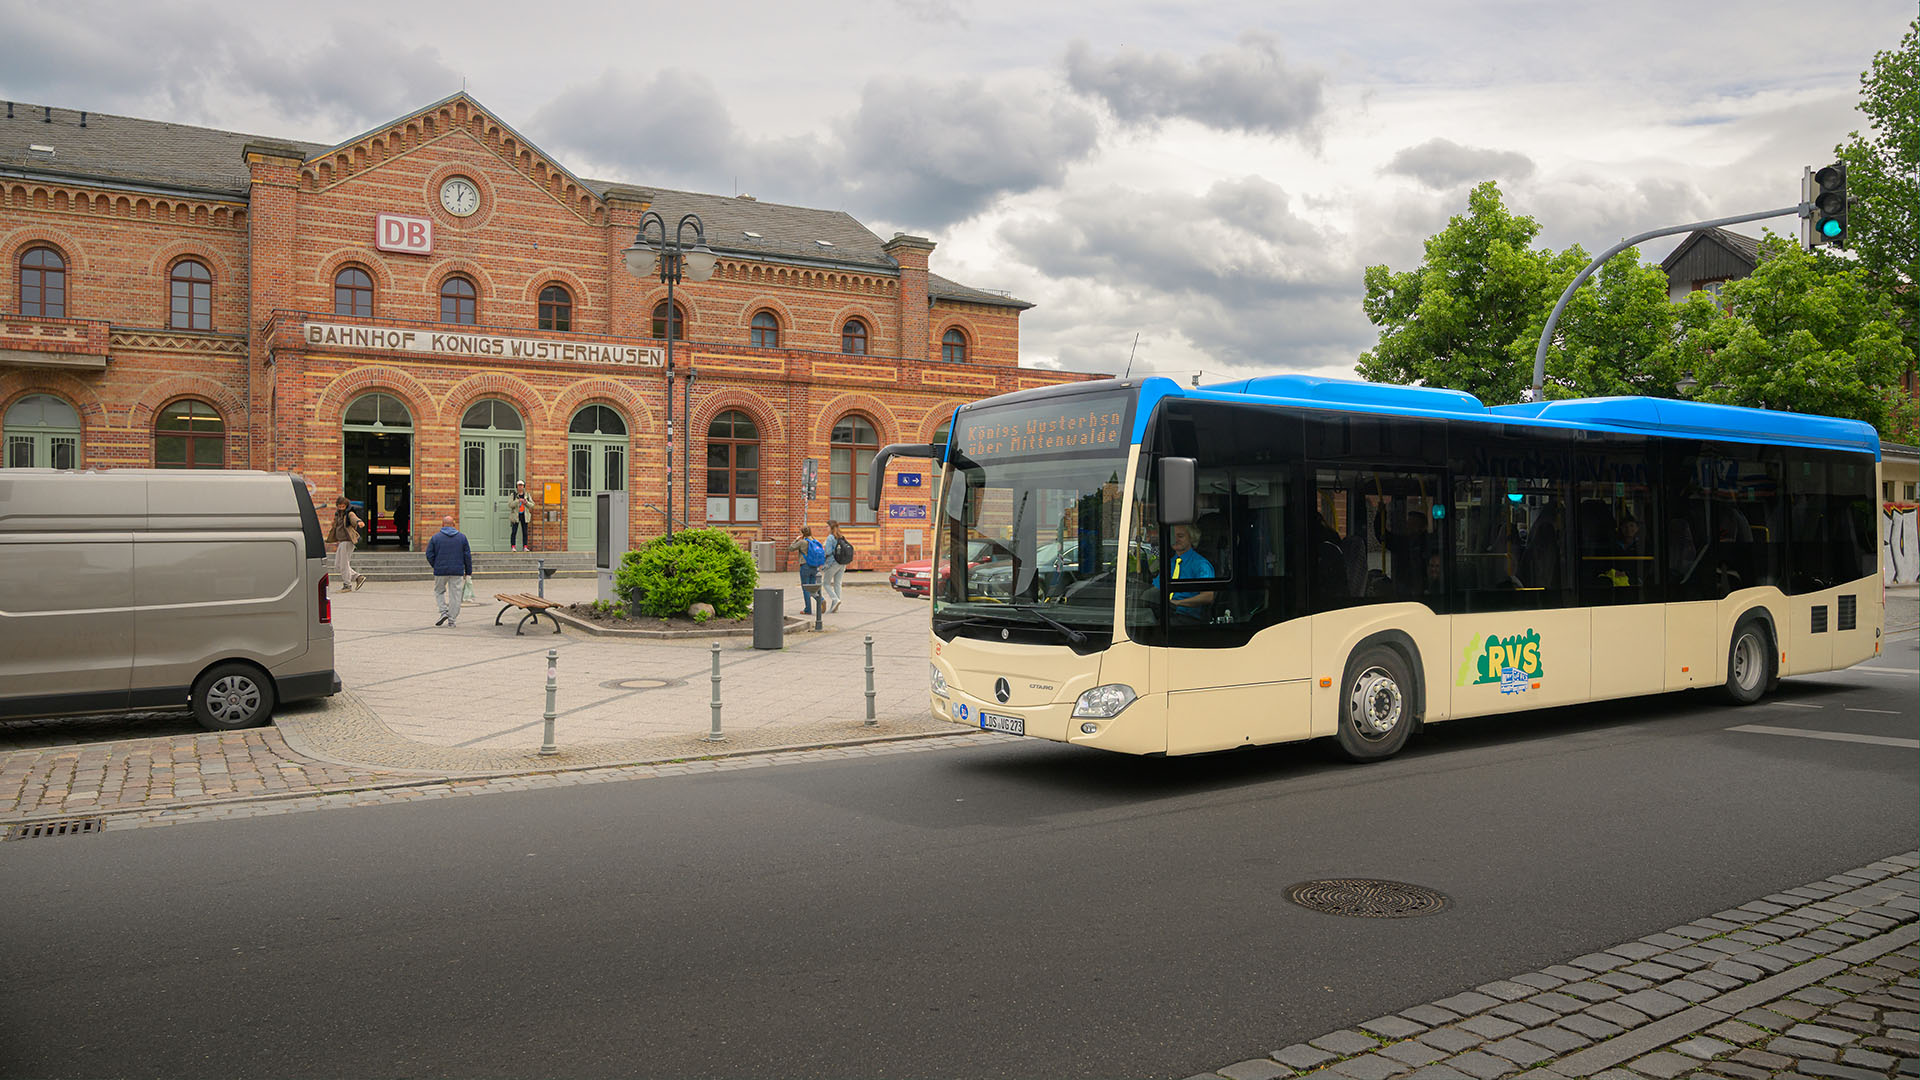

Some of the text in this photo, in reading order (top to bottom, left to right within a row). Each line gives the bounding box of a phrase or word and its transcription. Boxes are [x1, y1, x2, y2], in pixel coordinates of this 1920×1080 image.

[384, 219, 426, 247] DB
[309, 325, 661, 365] BAHNHOF KÖNIGS WUSTERHAUSEN
[968, 412, 1120, 441] Königs Wusterhsn
[968, 428, 1118, 455] über Mittenwalde
[1488, 642, 1538, 678] RVS
[1010, 719, 1022, 733] 273
